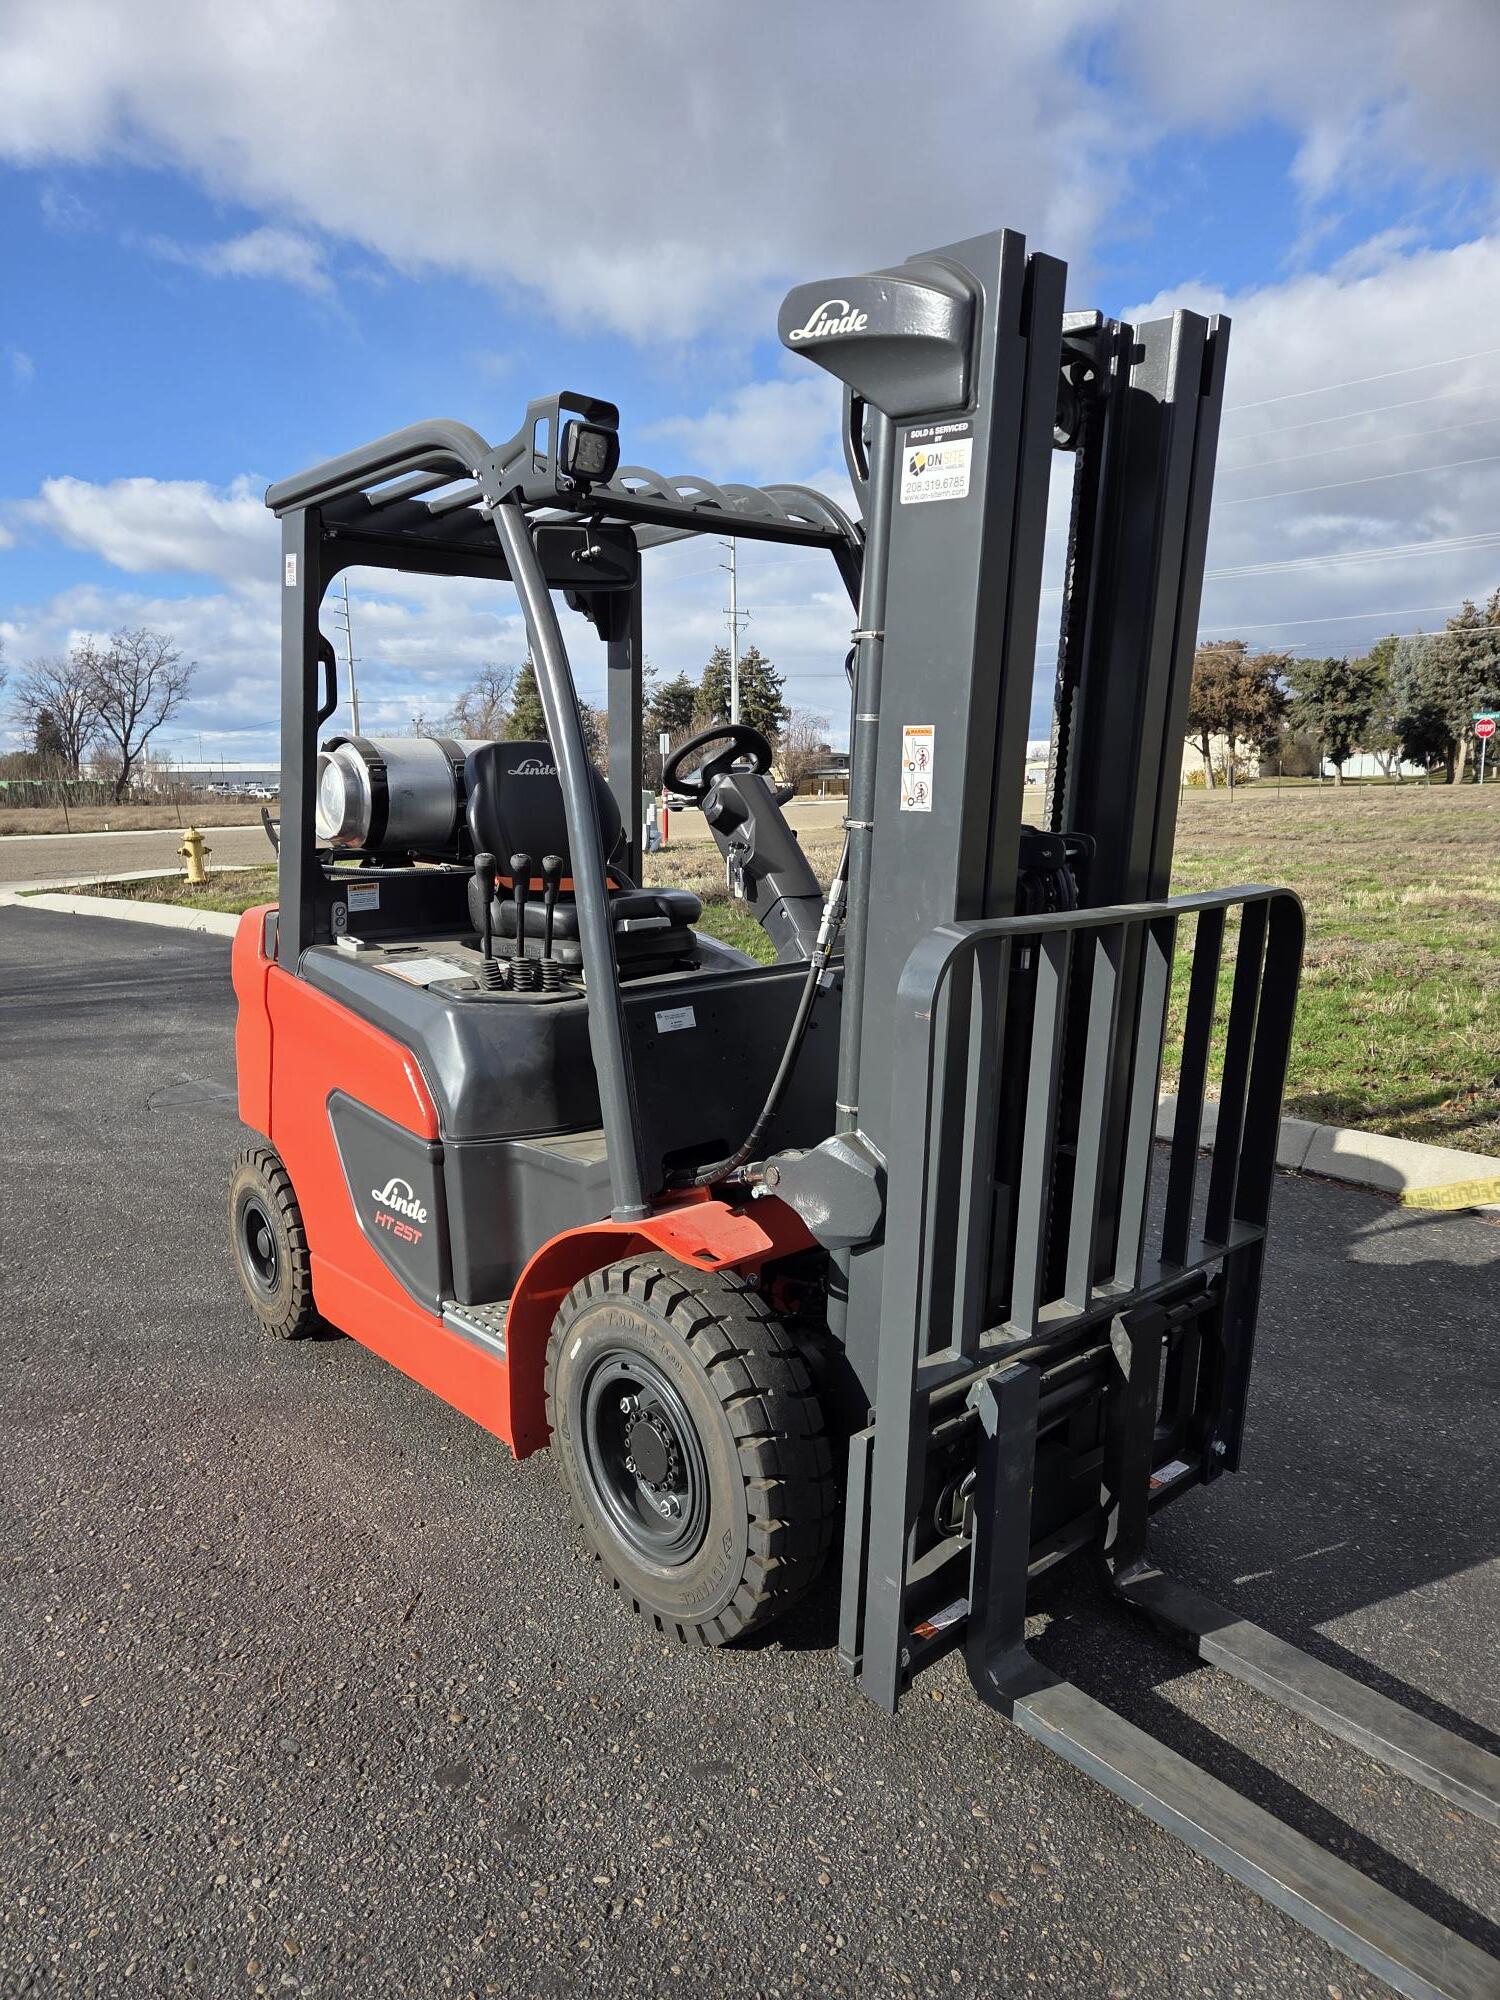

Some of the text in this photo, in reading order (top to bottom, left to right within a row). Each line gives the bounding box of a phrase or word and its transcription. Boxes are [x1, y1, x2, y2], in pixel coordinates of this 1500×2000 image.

[789, 299, 868, 341] Linde
[910, 428, 928, 438] SOLD
[935, 423, 968, 434] SERVICED
[1477, 724, 1494, 732] STOP
[507, 758, 557, 776] Linde
[371, 1177, 428, 1224] Linde
